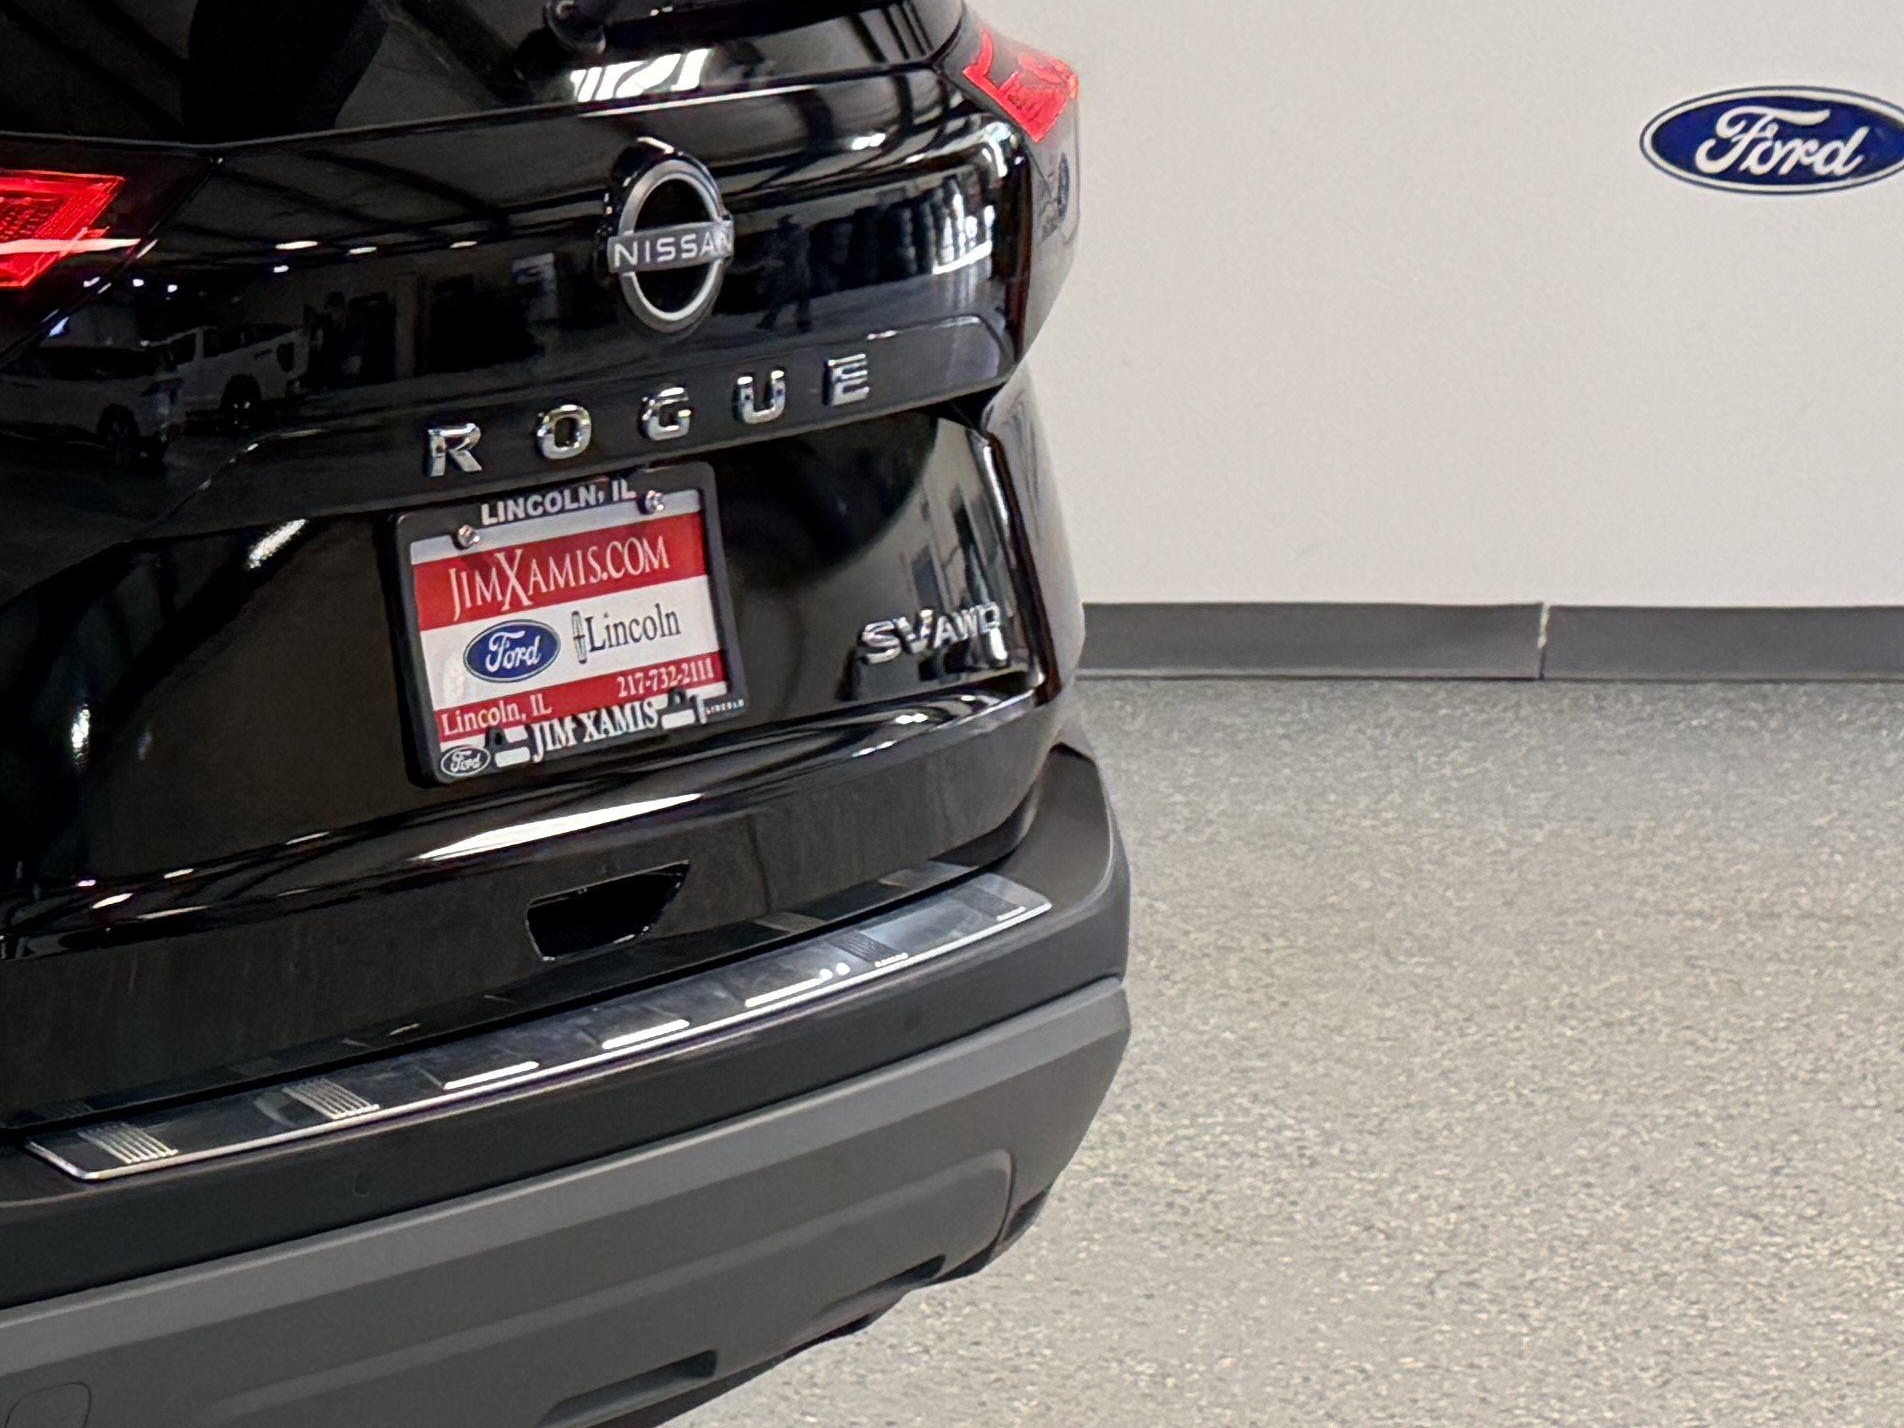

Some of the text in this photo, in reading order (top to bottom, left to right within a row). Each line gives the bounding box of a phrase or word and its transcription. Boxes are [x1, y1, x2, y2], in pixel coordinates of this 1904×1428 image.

[1694, 105, 1871, 177] Ford
[613, 231, 734, 269] NISSAN
[427, 352, 871, 477] ROGUE
[479, 476, 638, 527] LINCOLN, IL
[484, 602, 682, 673] Ford Lincoln
[442, 692, 553, 736] Lincoln, IL
[449, 749, 482, 771] Ford
[531, 719, 579, 763] JIM
[581, 696, 659, 743] XAMIS
